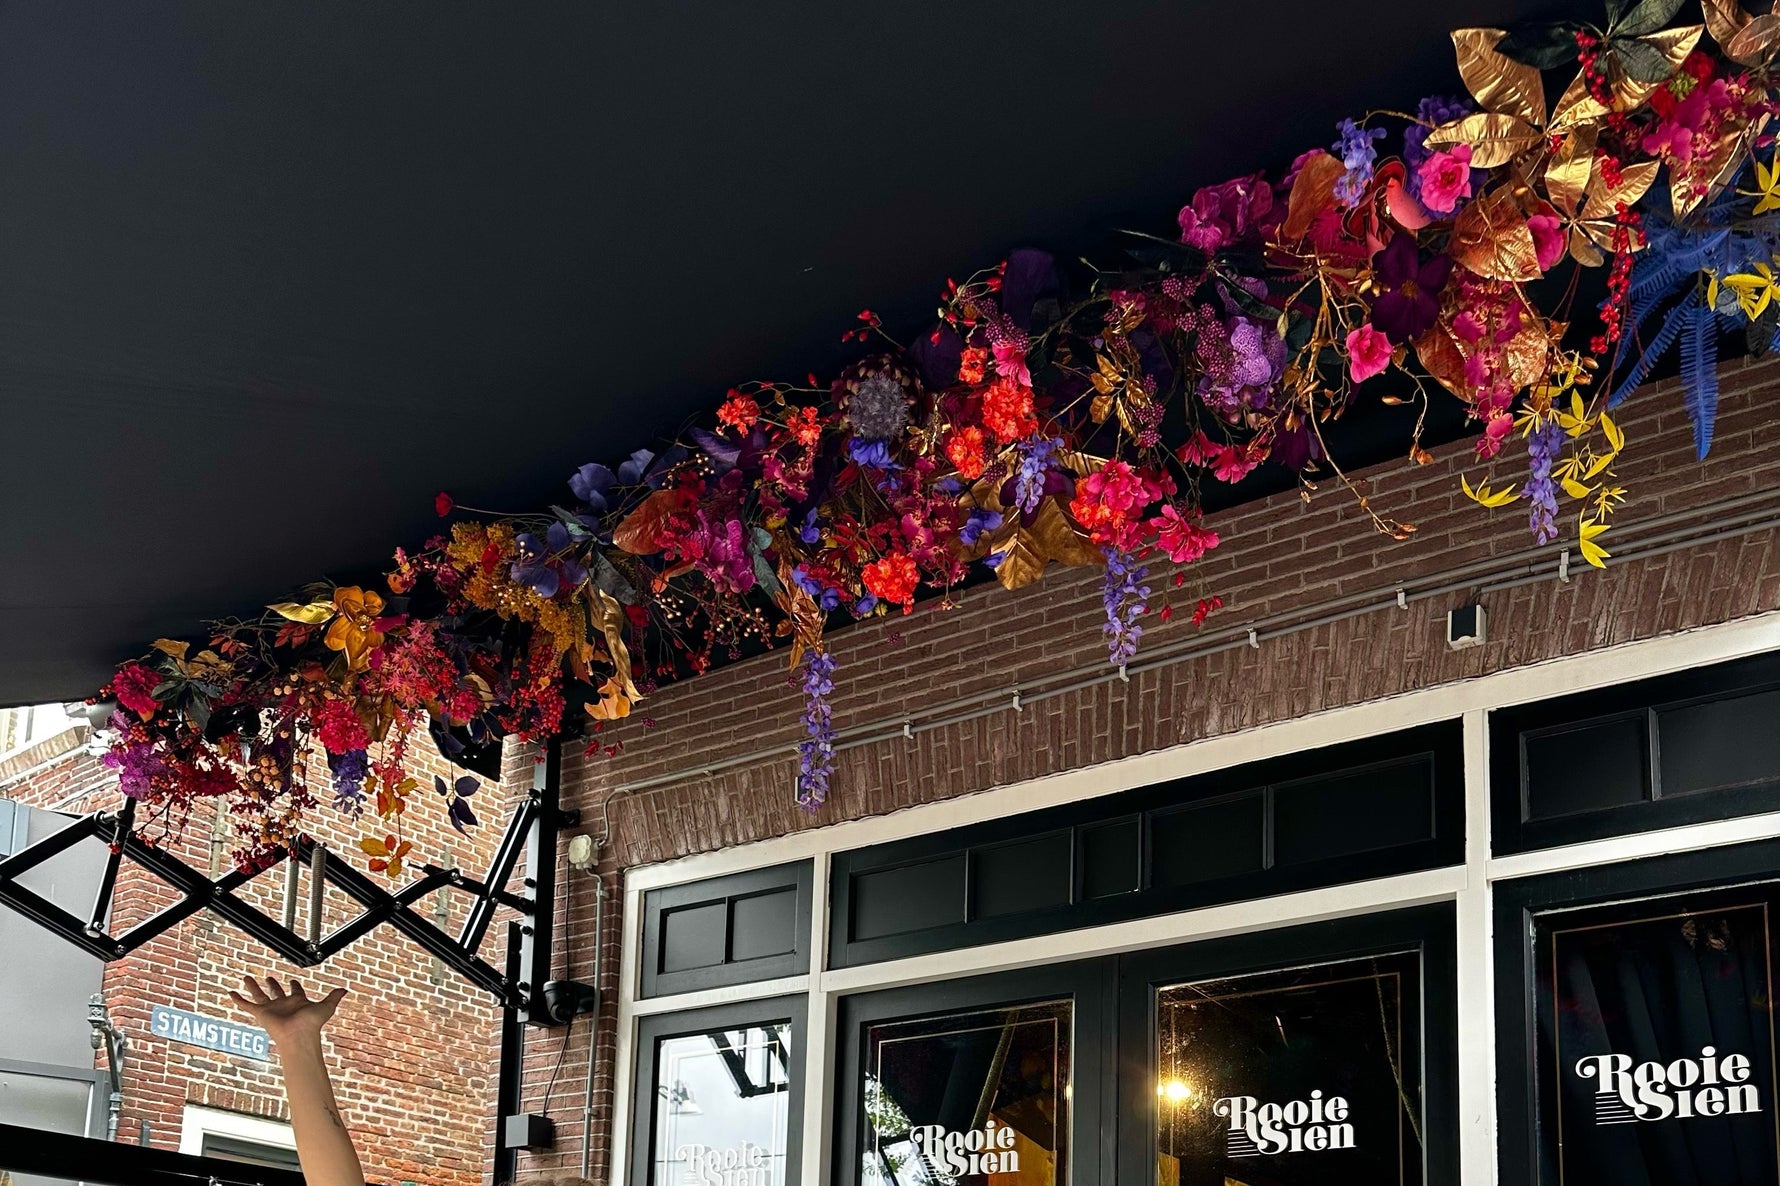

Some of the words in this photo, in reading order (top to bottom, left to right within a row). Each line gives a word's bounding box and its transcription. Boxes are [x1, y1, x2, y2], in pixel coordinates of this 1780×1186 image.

[157, 1011, 264, 1053] STAMSTEEG
[1575, 1045, 1751, 1106] Rooie
[1213, 1089, 1349, 1143] Rooie
[1634, 1080, 1764, 1121] Sien
[910, 1120, 1016, 1165] Rooie
[1257, 1120, 1357, 1155] Sien
[675, 1140, 763, 1182] Rooie
[946, 1147, 1021, 1178] Sien
